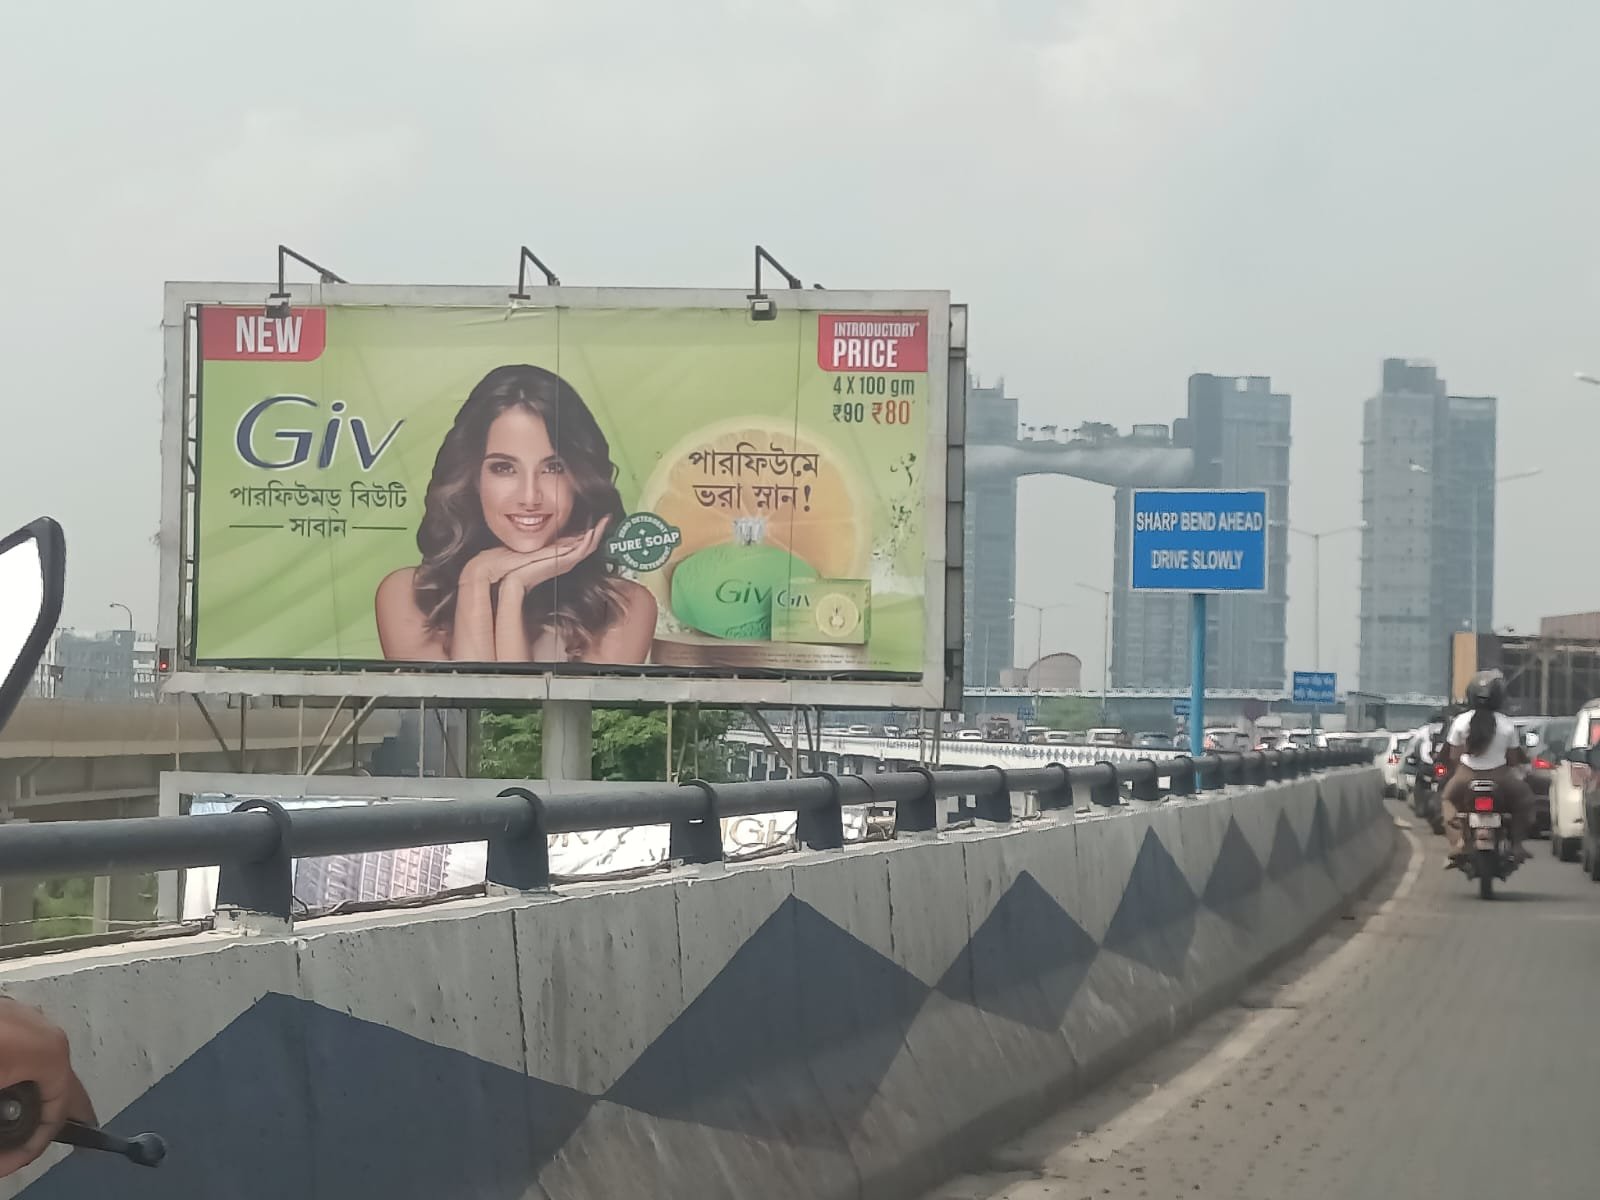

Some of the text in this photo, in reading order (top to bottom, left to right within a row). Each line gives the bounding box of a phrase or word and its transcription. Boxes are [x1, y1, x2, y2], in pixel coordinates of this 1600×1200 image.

[236, 316, 302, 352] NEW
[833, 338, 898, 368] PRICE
[833, 376, 841, 394] 4
[859, 376, 886, 395] 100
[890, 379, 915, 397] gm
[235, 394, 405, 471] Giv
[688, 442, 819, 477] পারফিউমে
[350, 480, 408, 509] বিউটি
[692, 483, 742, 509] ভরা
[289, 516, 347, 538] সাবান
[1136, 511, 1263, 531] SHARP BEND AHEAD
[609, 531, 680, 554] PURE SOAP
[1151, 549, 1244, 570] DRIVE SLOWLY
[715, 578, 772, 604] Giv
